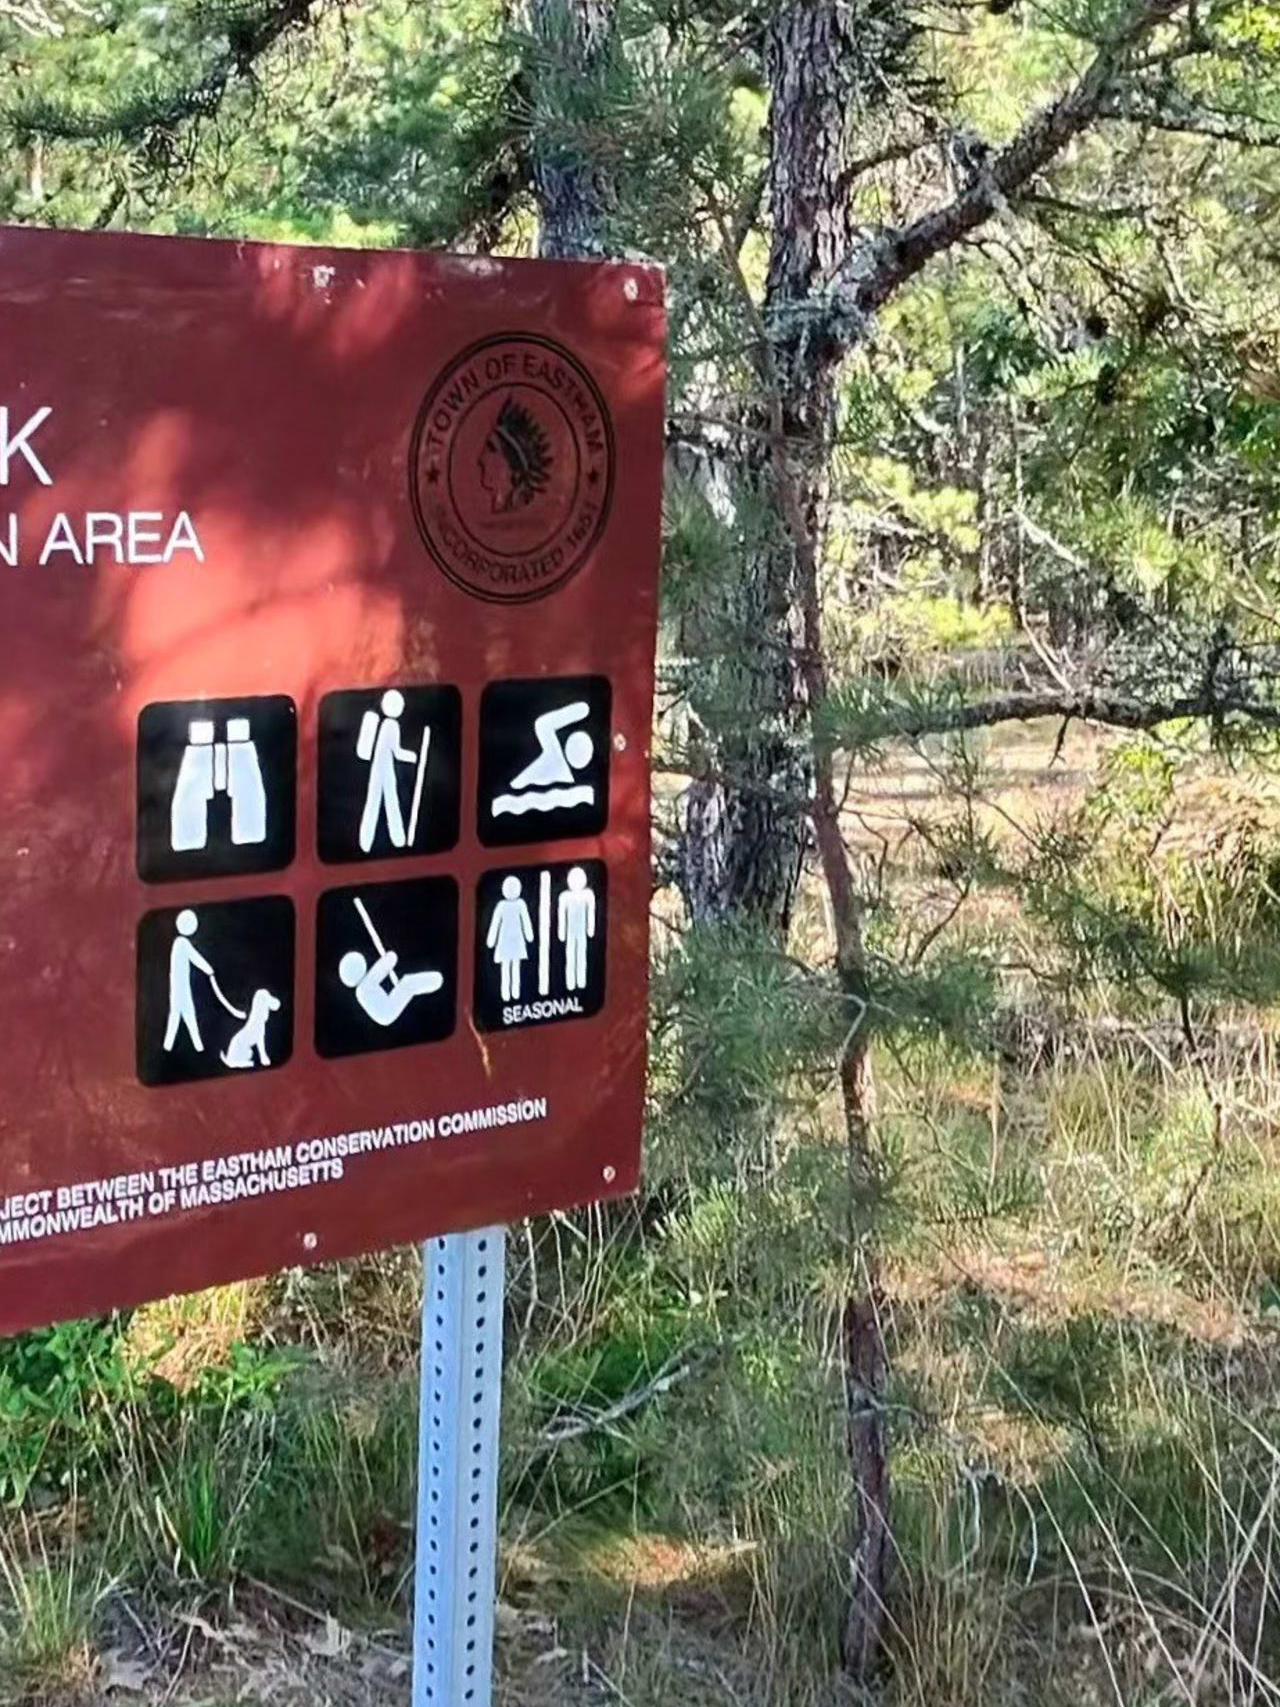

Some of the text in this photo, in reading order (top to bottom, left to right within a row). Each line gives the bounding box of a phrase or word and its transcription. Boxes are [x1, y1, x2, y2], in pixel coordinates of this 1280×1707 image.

[426, 352, 604, 454] TOWN OF EASTHAM
[38, 510, 206, 566] AREA
[433, 504, 564, 584] CORPORATED
[502, 996, 585, 1025] SEASONAL
[57, 1173, 156, 1210] BETWEEN
[158, 1162, 199, 1190] THE
[202, 1143, 293, 1179] EASTHAM
[295, 1118, 435, 1164] CONSERVATION
[437, 1097, 548, 1137] COMMISSION
[148, 1190, 177, 1215] OF
[181, 1157, 345, 1210] MASSACHUSETTS
